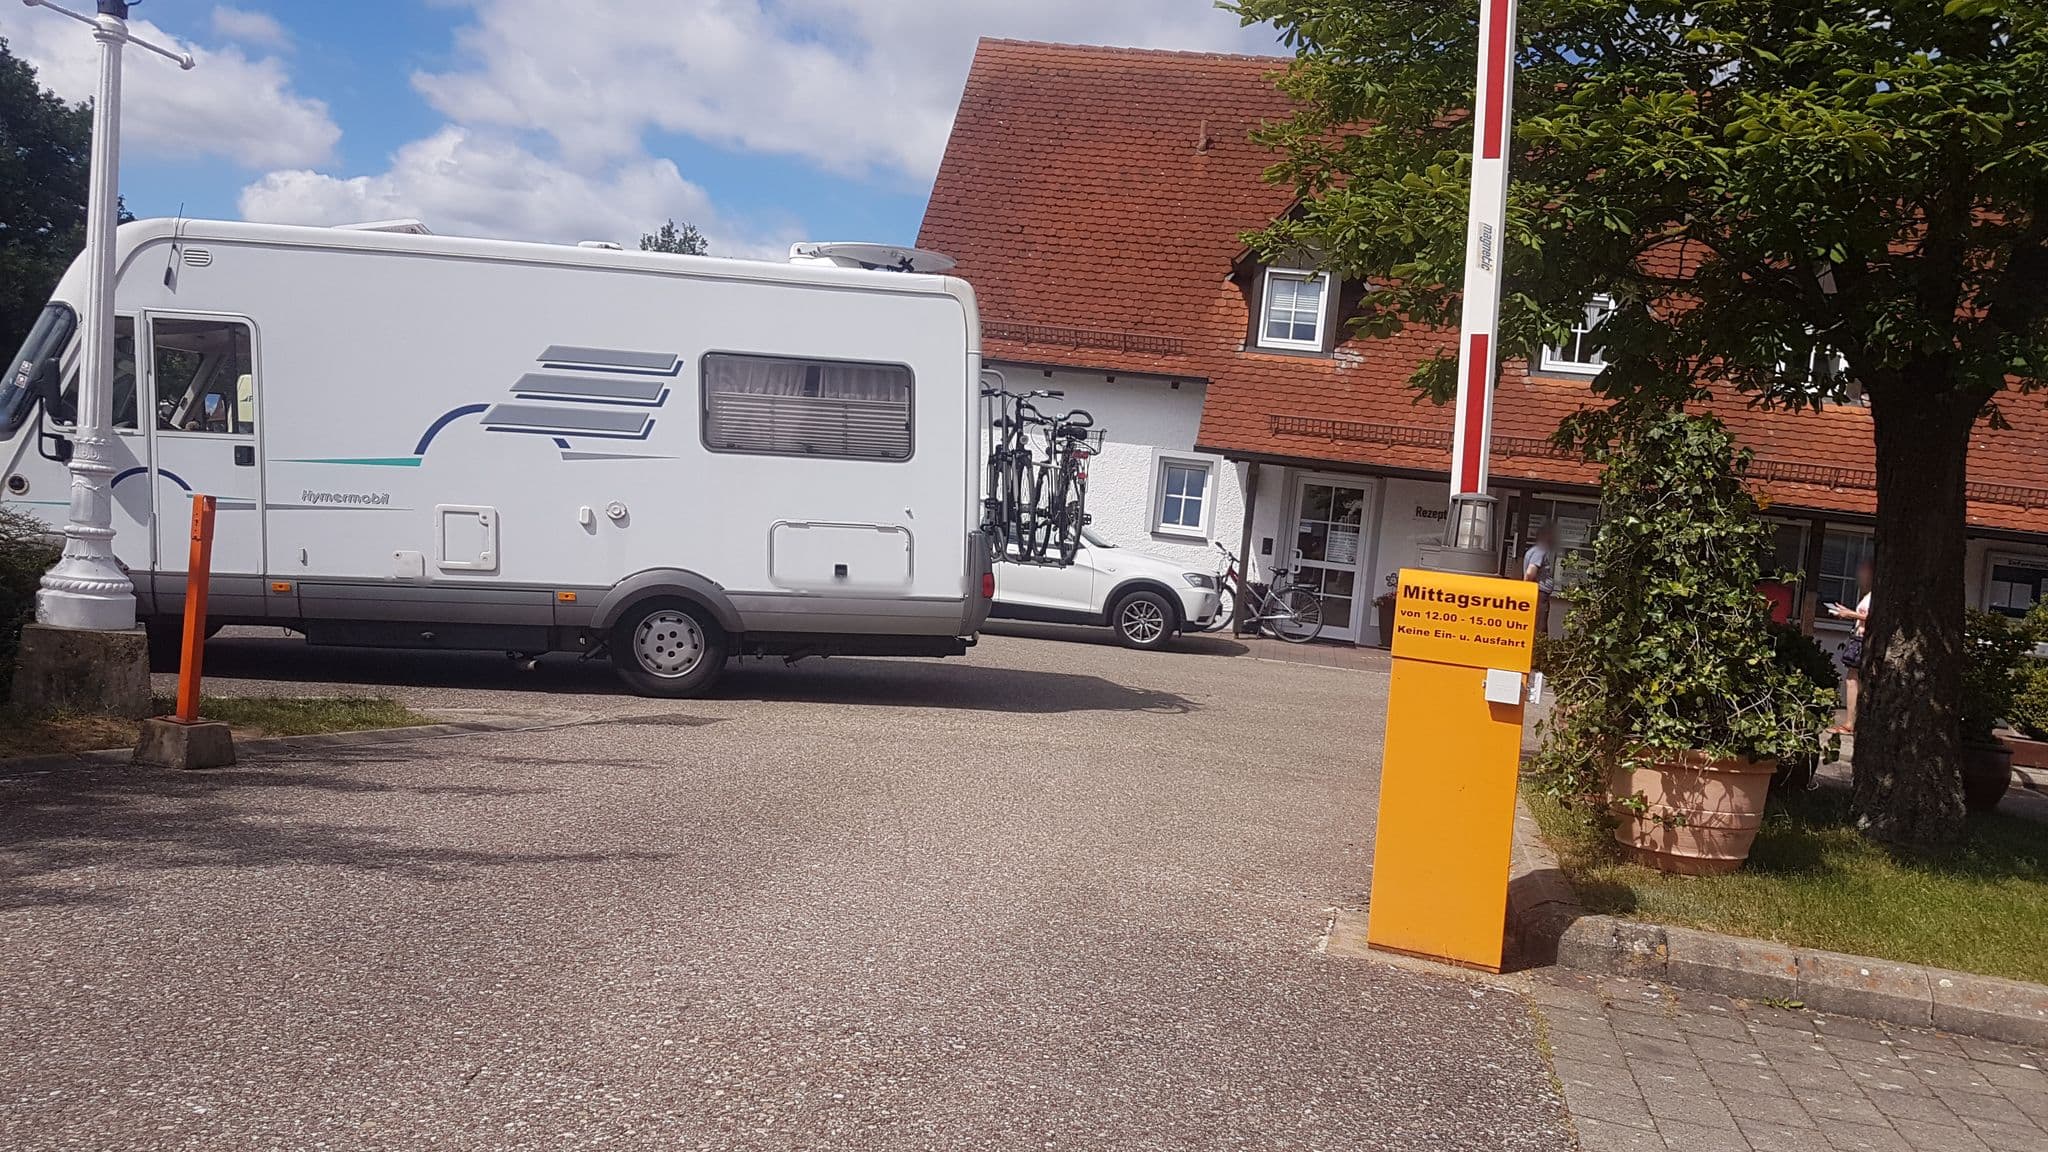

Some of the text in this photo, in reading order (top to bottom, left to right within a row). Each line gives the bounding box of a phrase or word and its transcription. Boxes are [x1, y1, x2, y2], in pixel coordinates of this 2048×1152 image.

[1480, 223, 1493, 271] magnetic
[301, 489, 390, 505] Hymermobil
[1415, 506, 1448, 522] Rezept
[1403, 584, 1531, 612] Mittagsruhe
[1400, 609, 1421, 618] von
[1425, 611, 1457, 623] 12.00
[1469, 616, 1502, 628] 15.00
[1506, 620, 1529, 631] Uhr
[1397, 625, 1526, 648] Keine Ein- u. Ausfahrt
